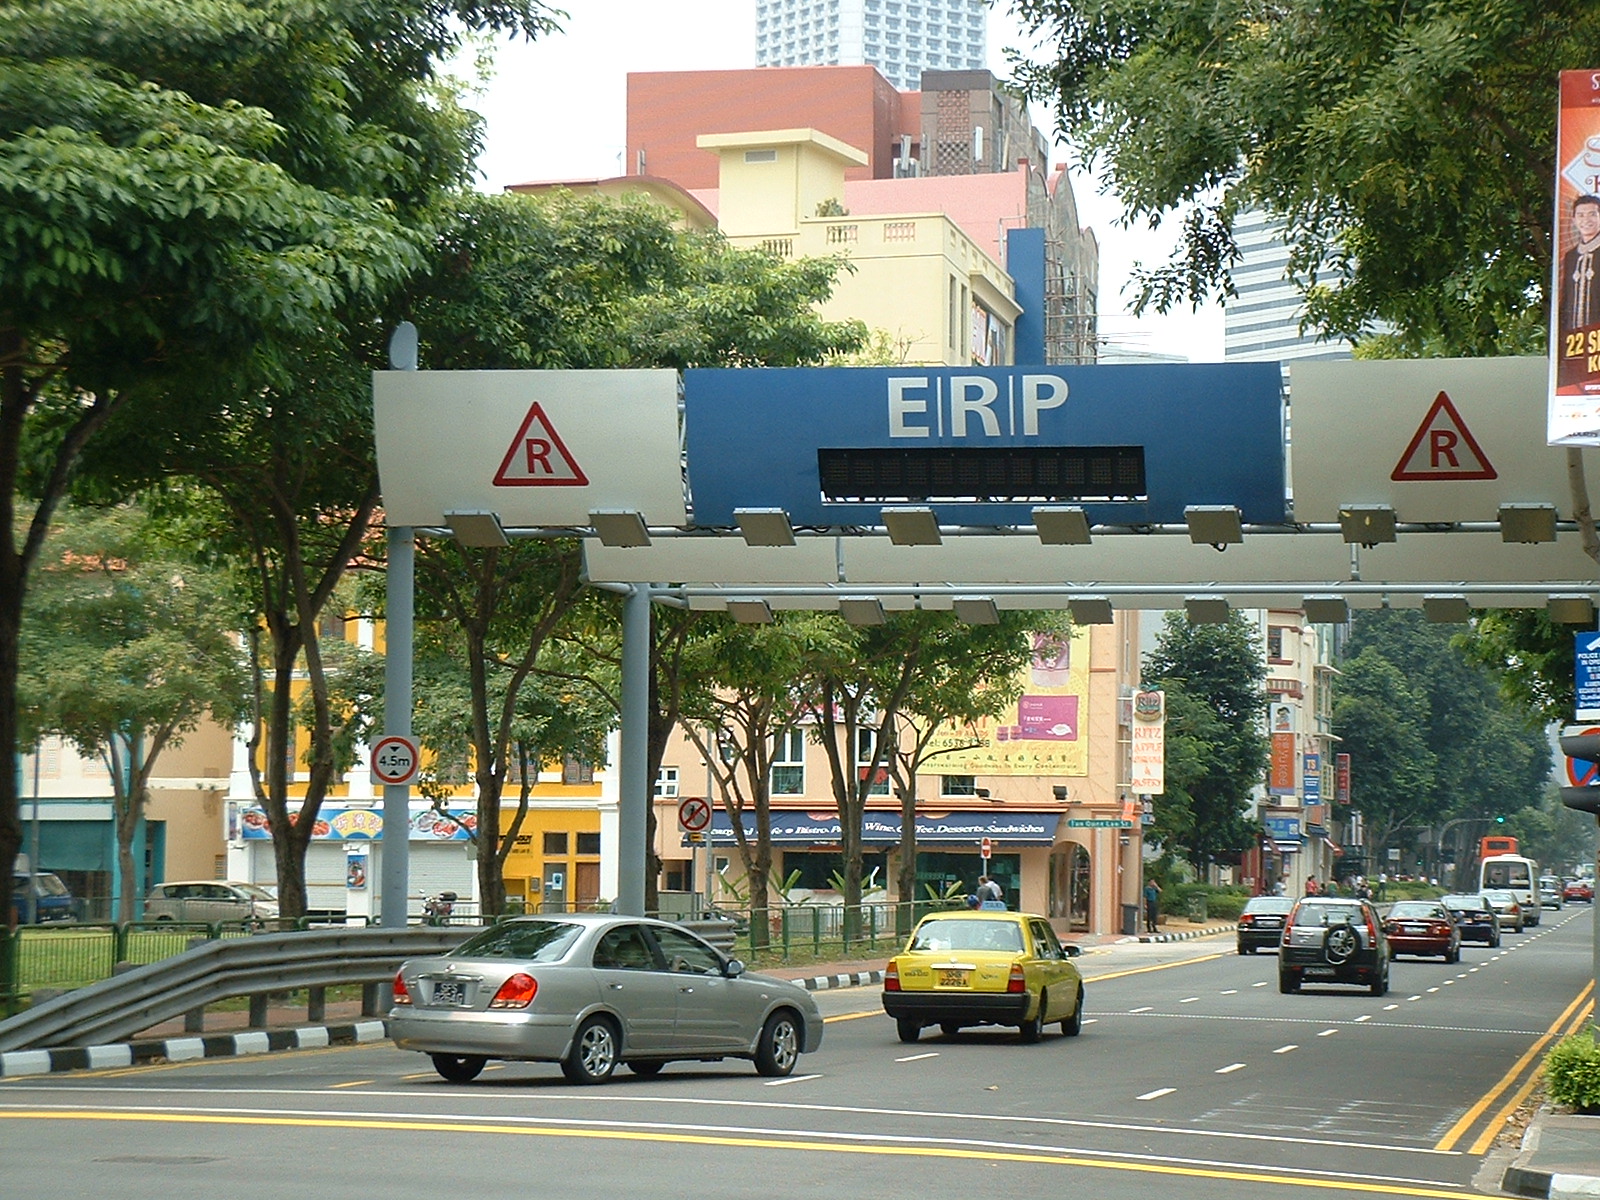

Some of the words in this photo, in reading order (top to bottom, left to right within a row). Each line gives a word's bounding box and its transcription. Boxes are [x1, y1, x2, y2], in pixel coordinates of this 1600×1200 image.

[1566, 332, 1584, 357] 22
[525, 438, 555, 474] R
[1429, 430, 1460, 467] R
[1134, 727, 1161, 739] RITZ
[1134, 743, 1162, 754] APPLE
[379, 755, 410, 767] 4.5m
